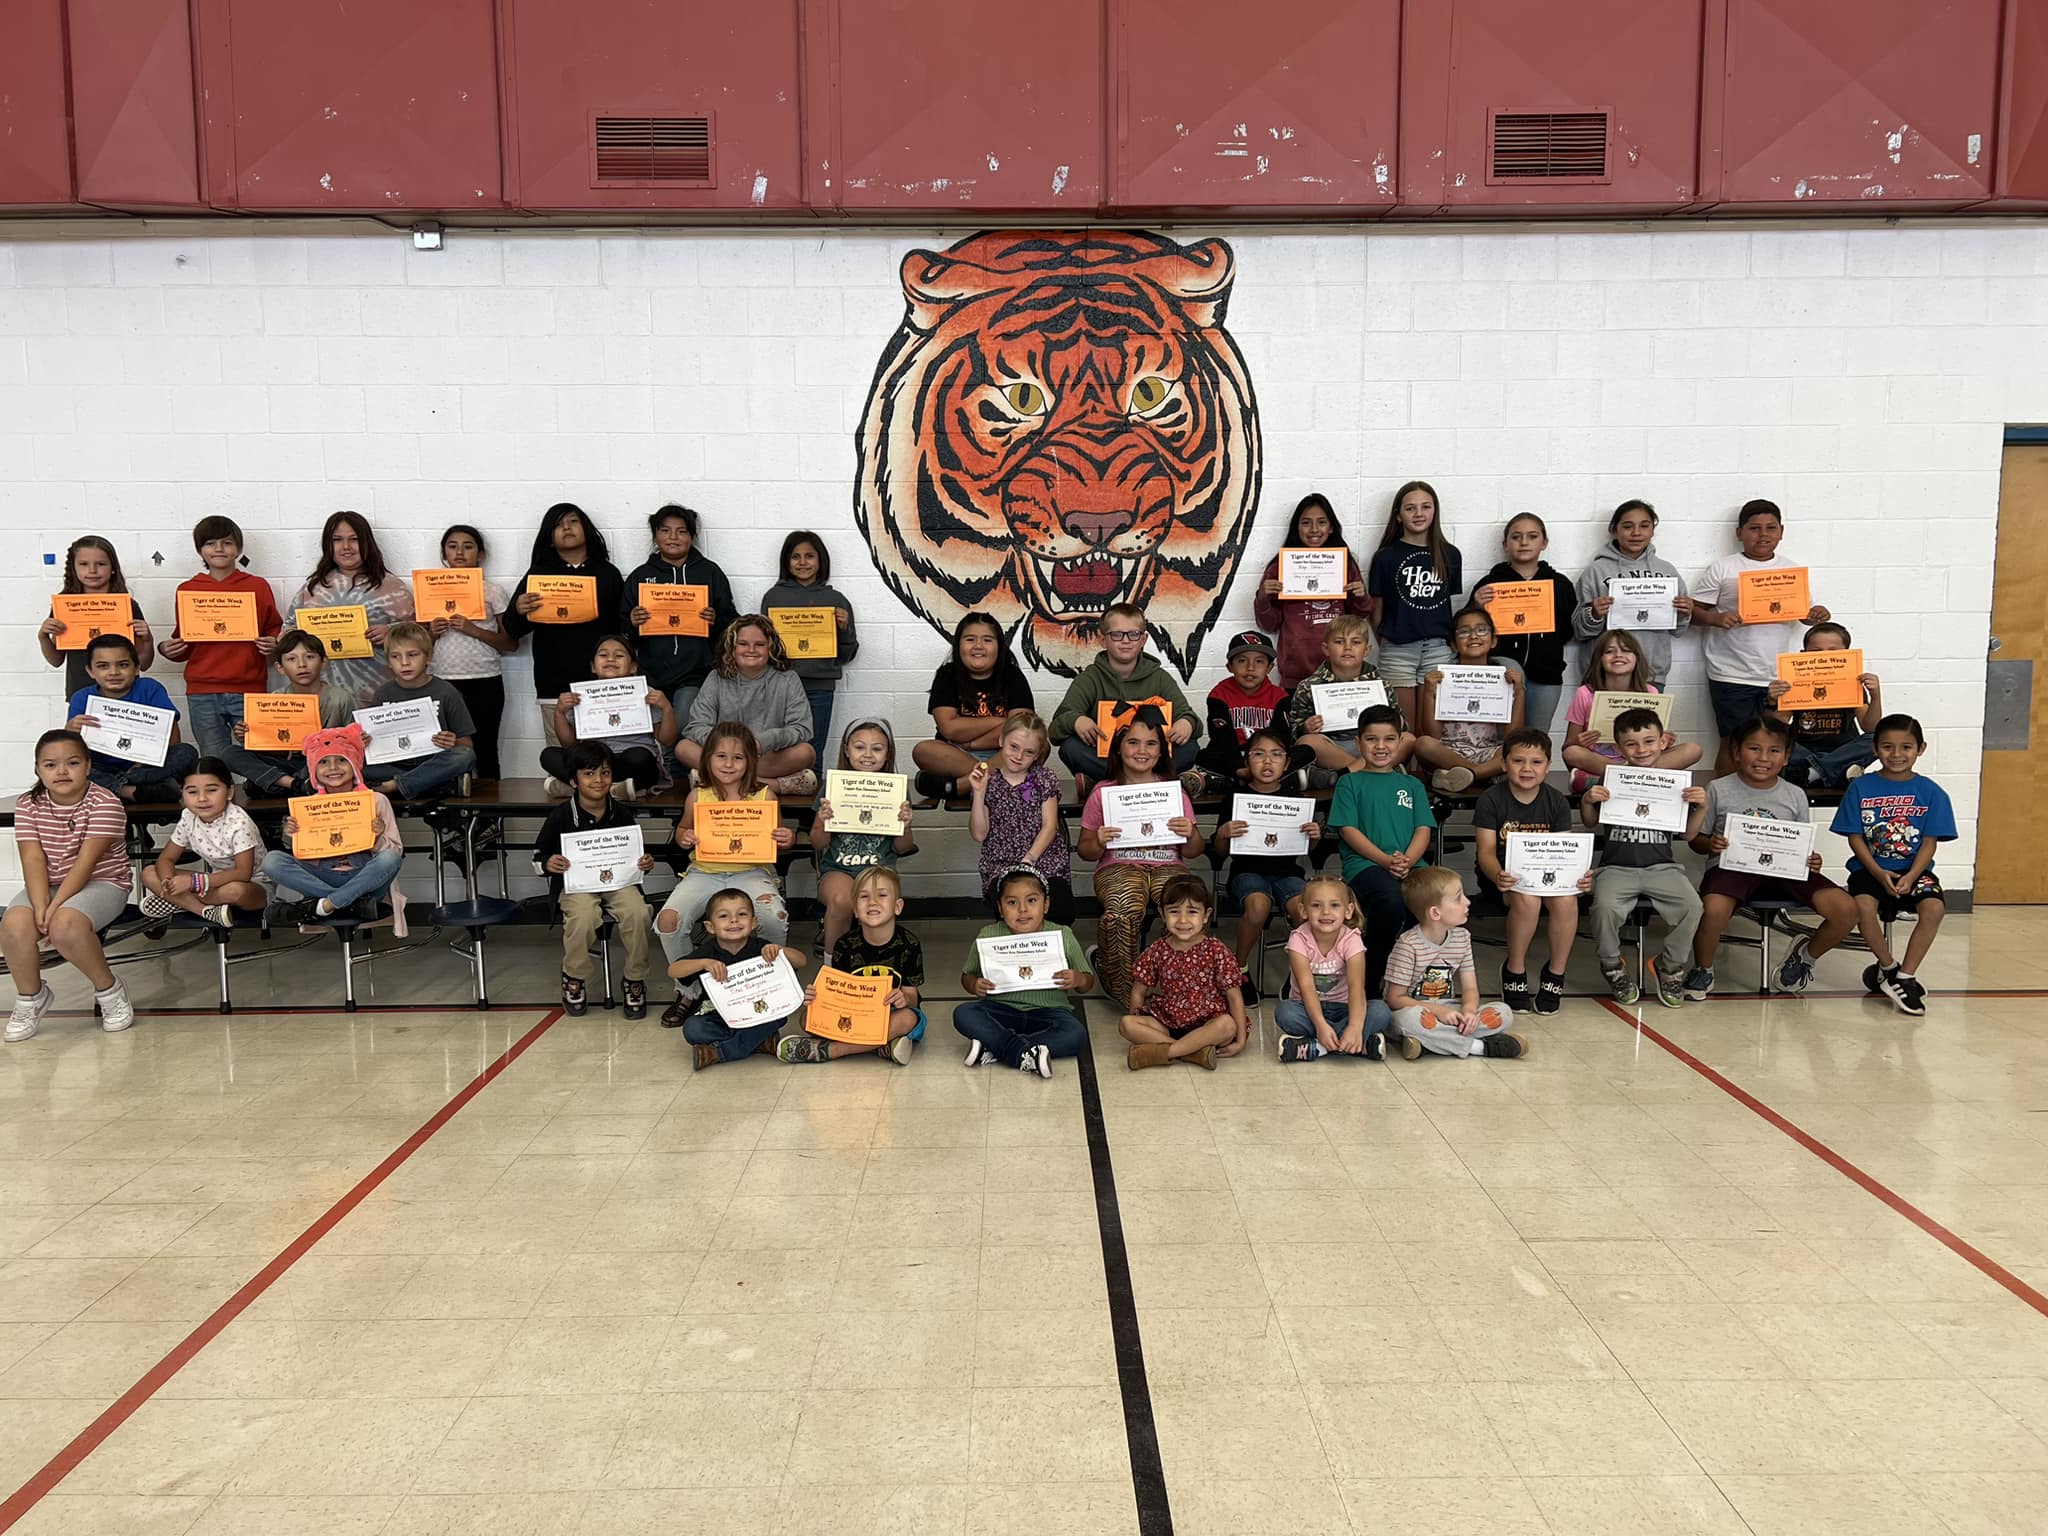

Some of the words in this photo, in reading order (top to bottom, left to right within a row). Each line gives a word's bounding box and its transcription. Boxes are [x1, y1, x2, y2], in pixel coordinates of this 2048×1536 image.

[1402, 565, 1443, 586] Holl
[1409, 582, 1441, 598] ster
[103, 705, 121, 713] Tiger
[142, 712, 159, 721] Week
[1818, 719, 1841, 729] TIGER
[877, 780, 893, 788] Week
[1658, 776, 1675, 784] Week
[1247, 802, 1263, 810] Tiger
[1284, 804, 1300, 812] Week
[1861, 795, 1916, 808] MARIO
[1880, 806, 1929, 818] KART
[1741, 822, 1760, 830] Tiger
[1782, 827, 1800, 836] Week
[1610, 828, 1668, 844] BEYOND
[575, 839, 593, 847] Tiger
[825, 977, 839, 986] Tiger
[859, 984, 877, 992] Week
